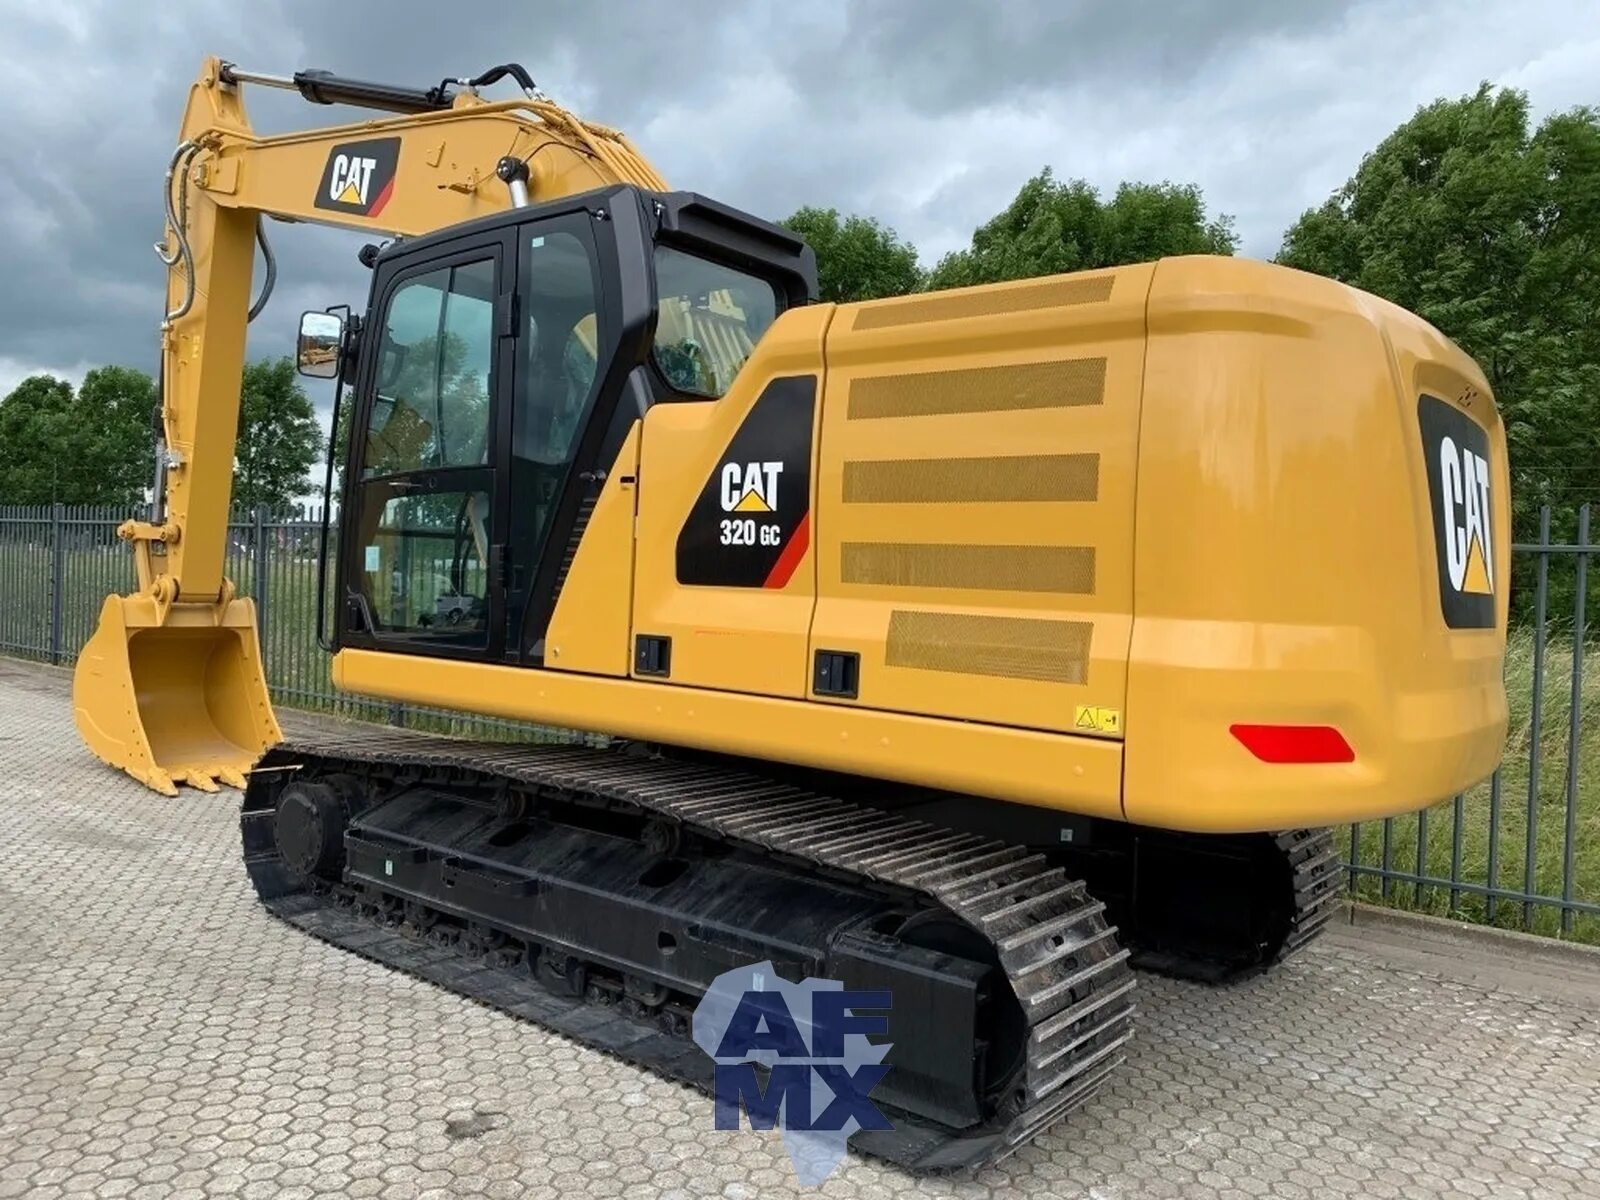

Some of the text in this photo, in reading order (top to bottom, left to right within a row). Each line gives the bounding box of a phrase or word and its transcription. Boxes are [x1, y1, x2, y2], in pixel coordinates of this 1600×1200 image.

[330, 154, 376, 205] CAT
[721, 462, 783, 511] CAT
[720, 520, 780, 546] 320 GC
[1440, 436, 1494, 595] CAT
